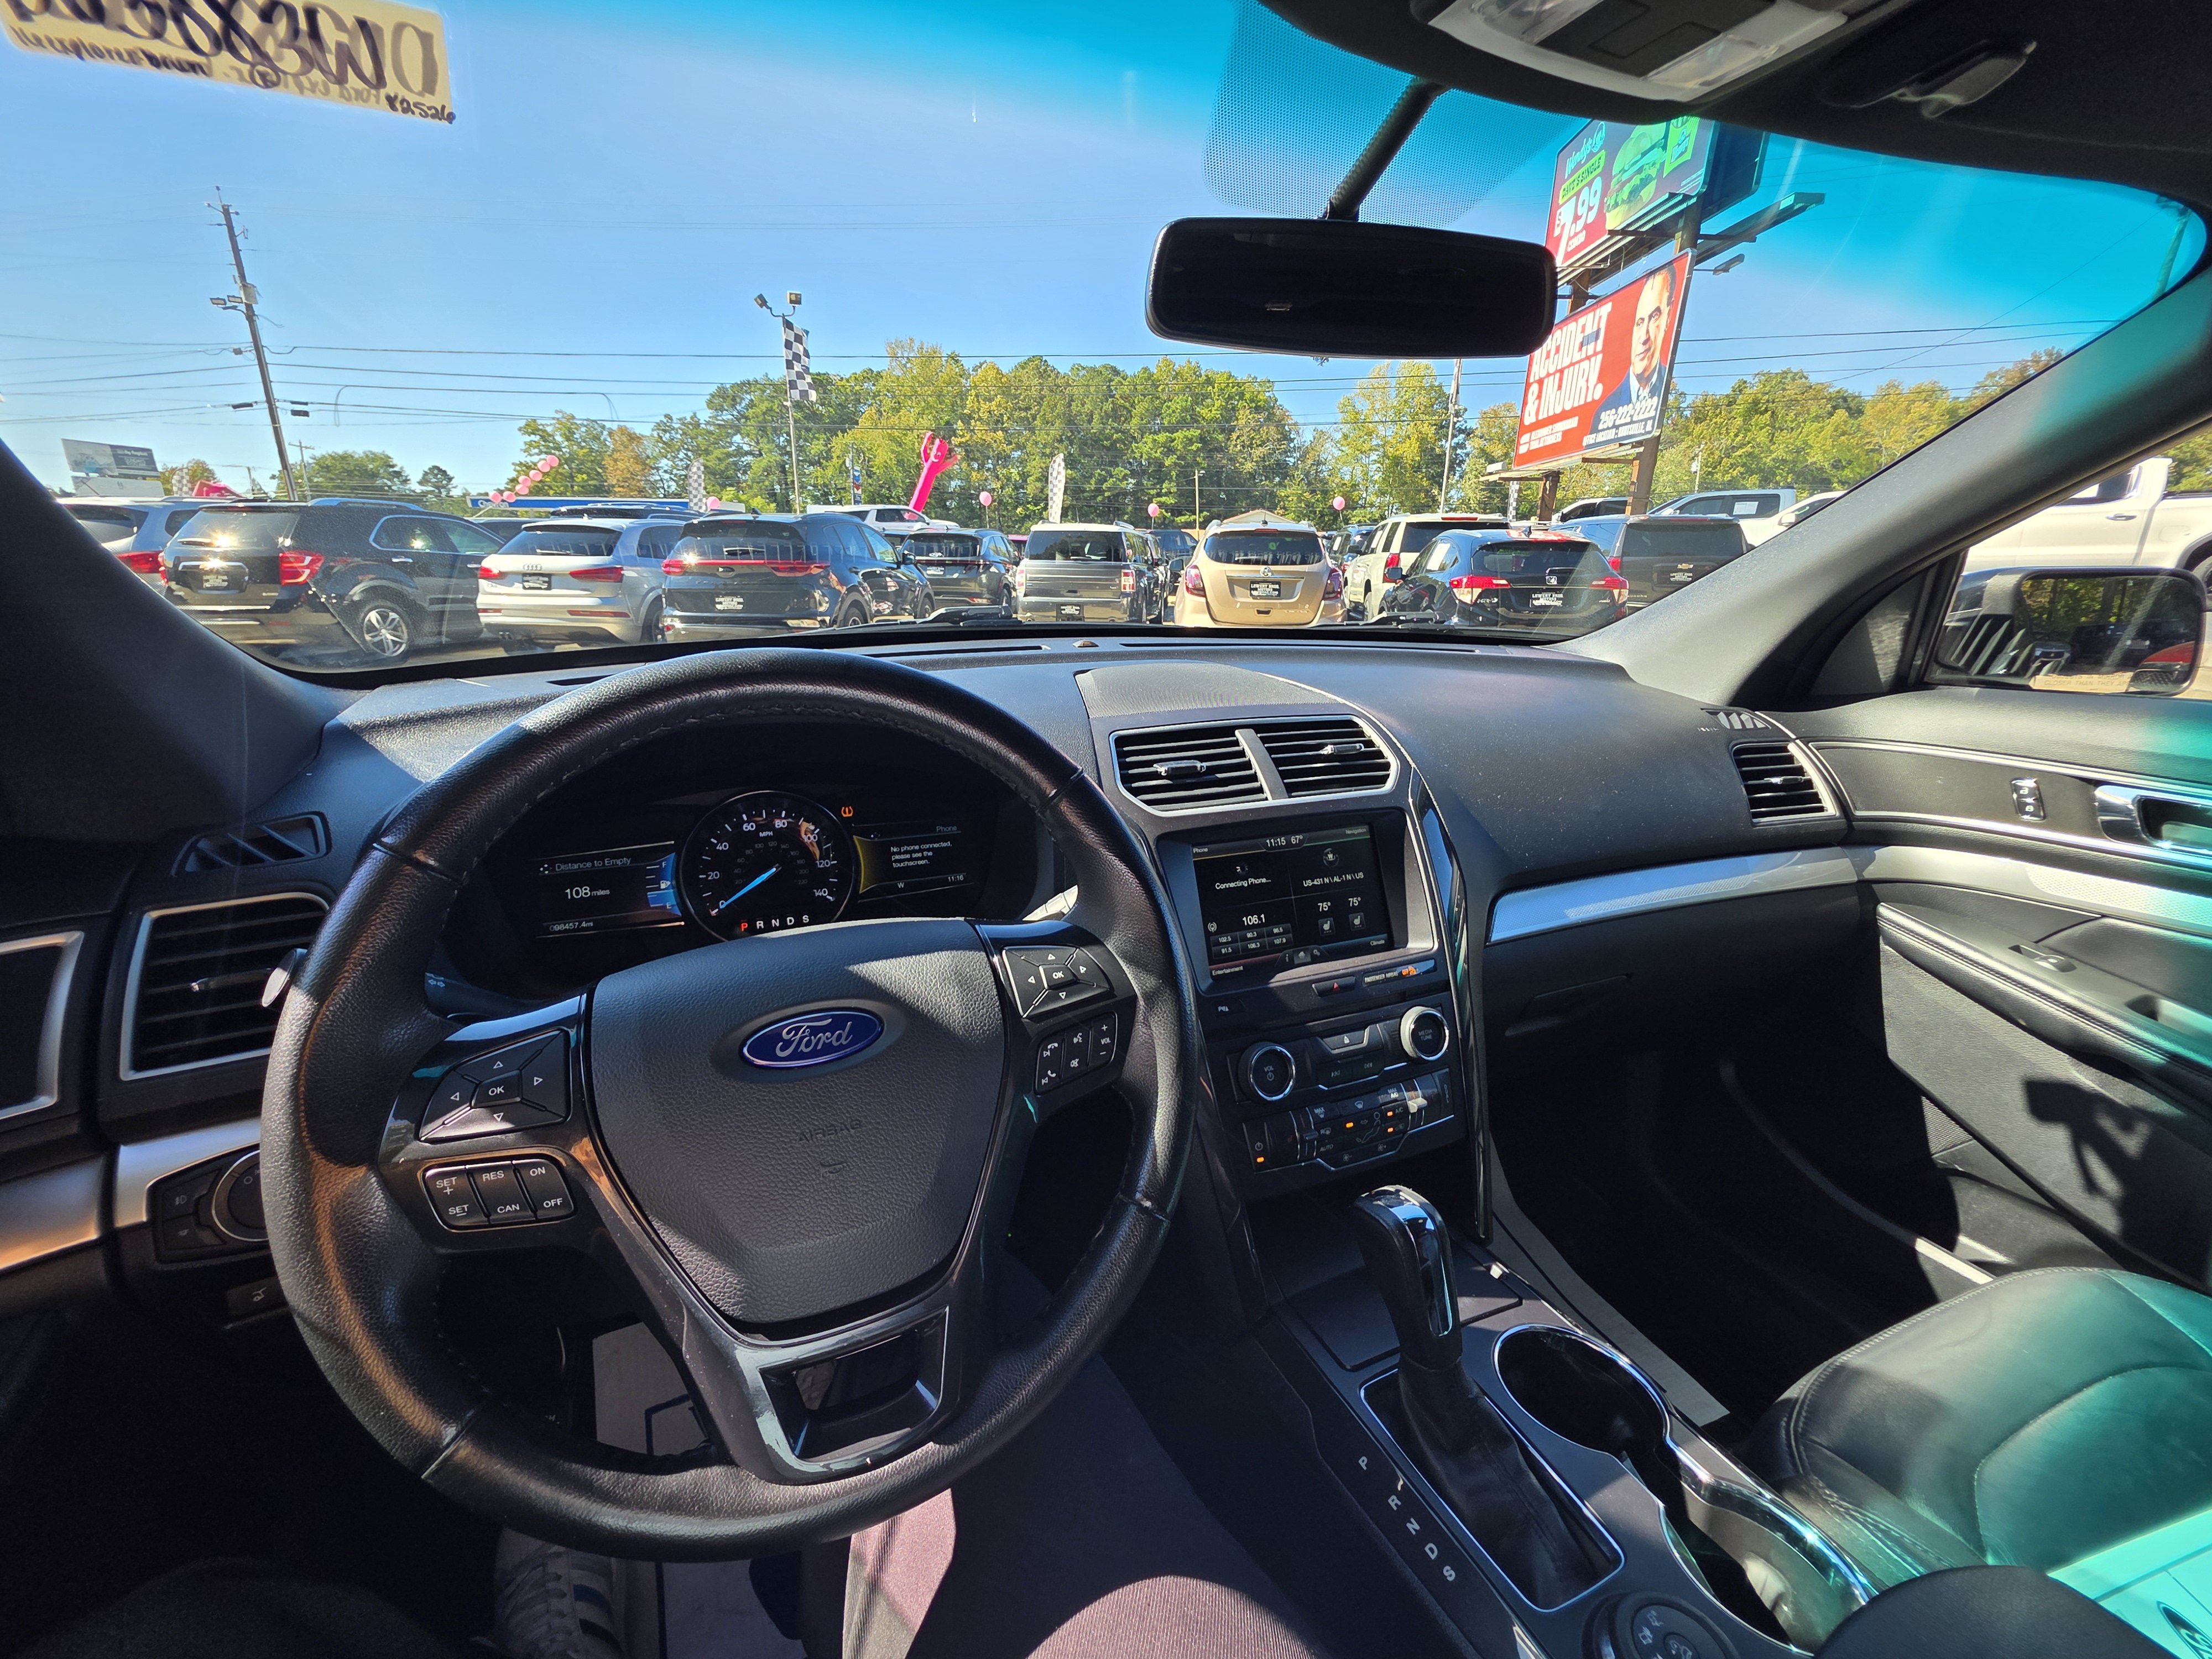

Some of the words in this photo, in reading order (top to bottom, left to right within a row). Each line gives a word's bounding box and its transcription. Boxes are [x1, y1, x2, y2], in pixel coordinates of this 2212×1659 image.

[1566, 137, 1592, 179] Wendy's
[1530, 301, 1612, 383] ACCIDENT
[1524, 383, 1539, 425] &
[743, 822, 755, 831] 60
[775, 820, 787, 828] 80
[716, 842, 729, 851] 40
[1266, 837, 1286, 847] 11:15
[555, 861, 592, 872] Distance
[604, 857, 631, 867] Empty
[816, 859, 830, 868] 120
[893, 859, 930, 868] touchscreen.
[1215, 879, 1248, 889] Connecting
[565, 886, 591, 899] 108
[591, 888, 610, 896] miles
[813, 888, 828, 896] 140
[741, 923, 748, 931] P
[757, 921, 764, 929] R
[771, 919, 779, 927] N
[786, 917, 795, 925] D
[802, 915, 810, 923] S
[1242, 914, 1265, 926] 106.1
[1212, 966, 1243, 976] Entertainment
[776, 1018, 853, 1057] Ford
[488, 1085, 504, 1096] OK
[482, 1170, 504, 1182] RES
[529, 1166, 546, 1177] ON
[436, 1176, 457, 1188] SET
[497, 1202, 520, 1214] CAN
[543, 1197, 564, 1208] OFF
[448, 1204, 469, 1215] SET
[1358, 1455, 1369, 1471] P
[1387, 1494, 1403, 1510] R
[1406, 1517, 1421, 1535] N
[1424, 1543, 1438, 1560] D
[1443, 1565, 1457, 1582] S
